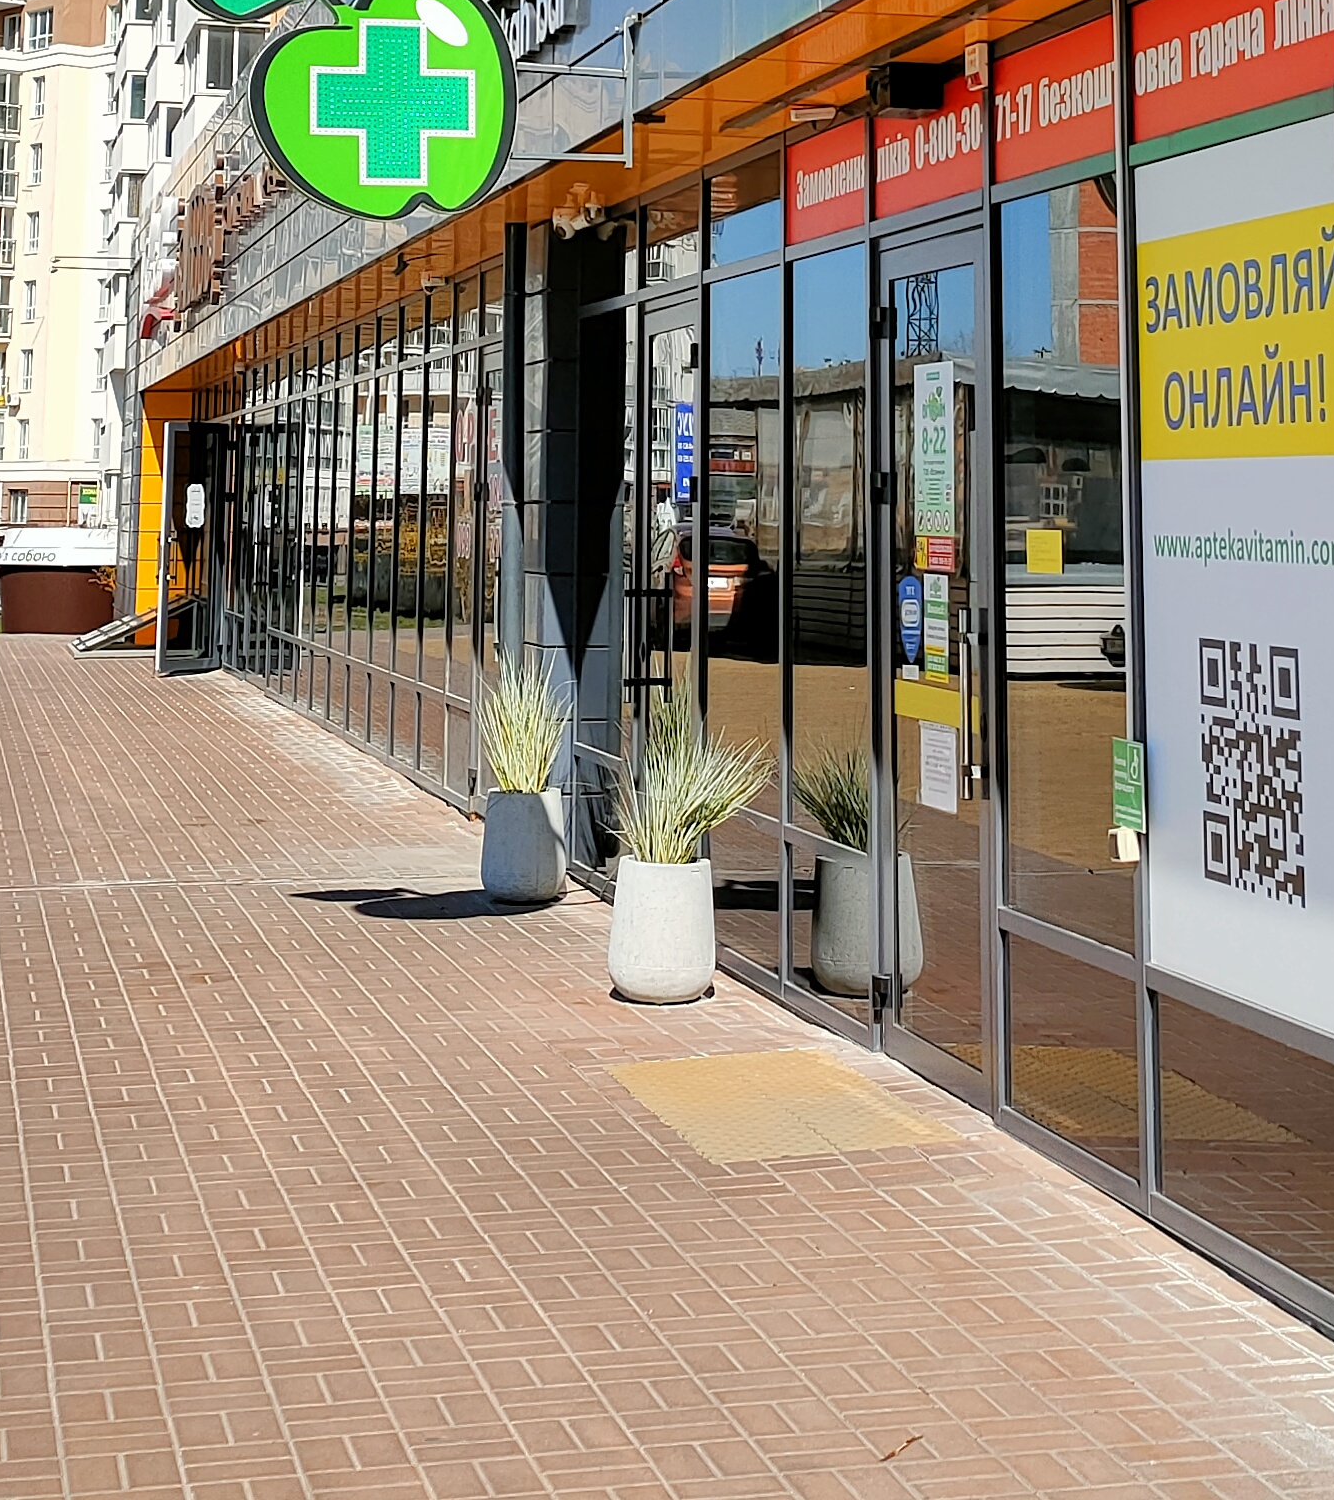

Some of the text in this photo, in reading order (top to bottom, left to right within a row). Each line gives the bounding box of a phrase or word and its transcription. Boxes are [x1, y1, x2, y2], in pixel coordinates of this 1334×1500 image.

[876, 132, 910, 183] ліків
[1189, 6, 1265, 79] гаряча
[1163, 343, 1327, 431] ОНЛАЙН!
[11, 549, 56, 562] собою
